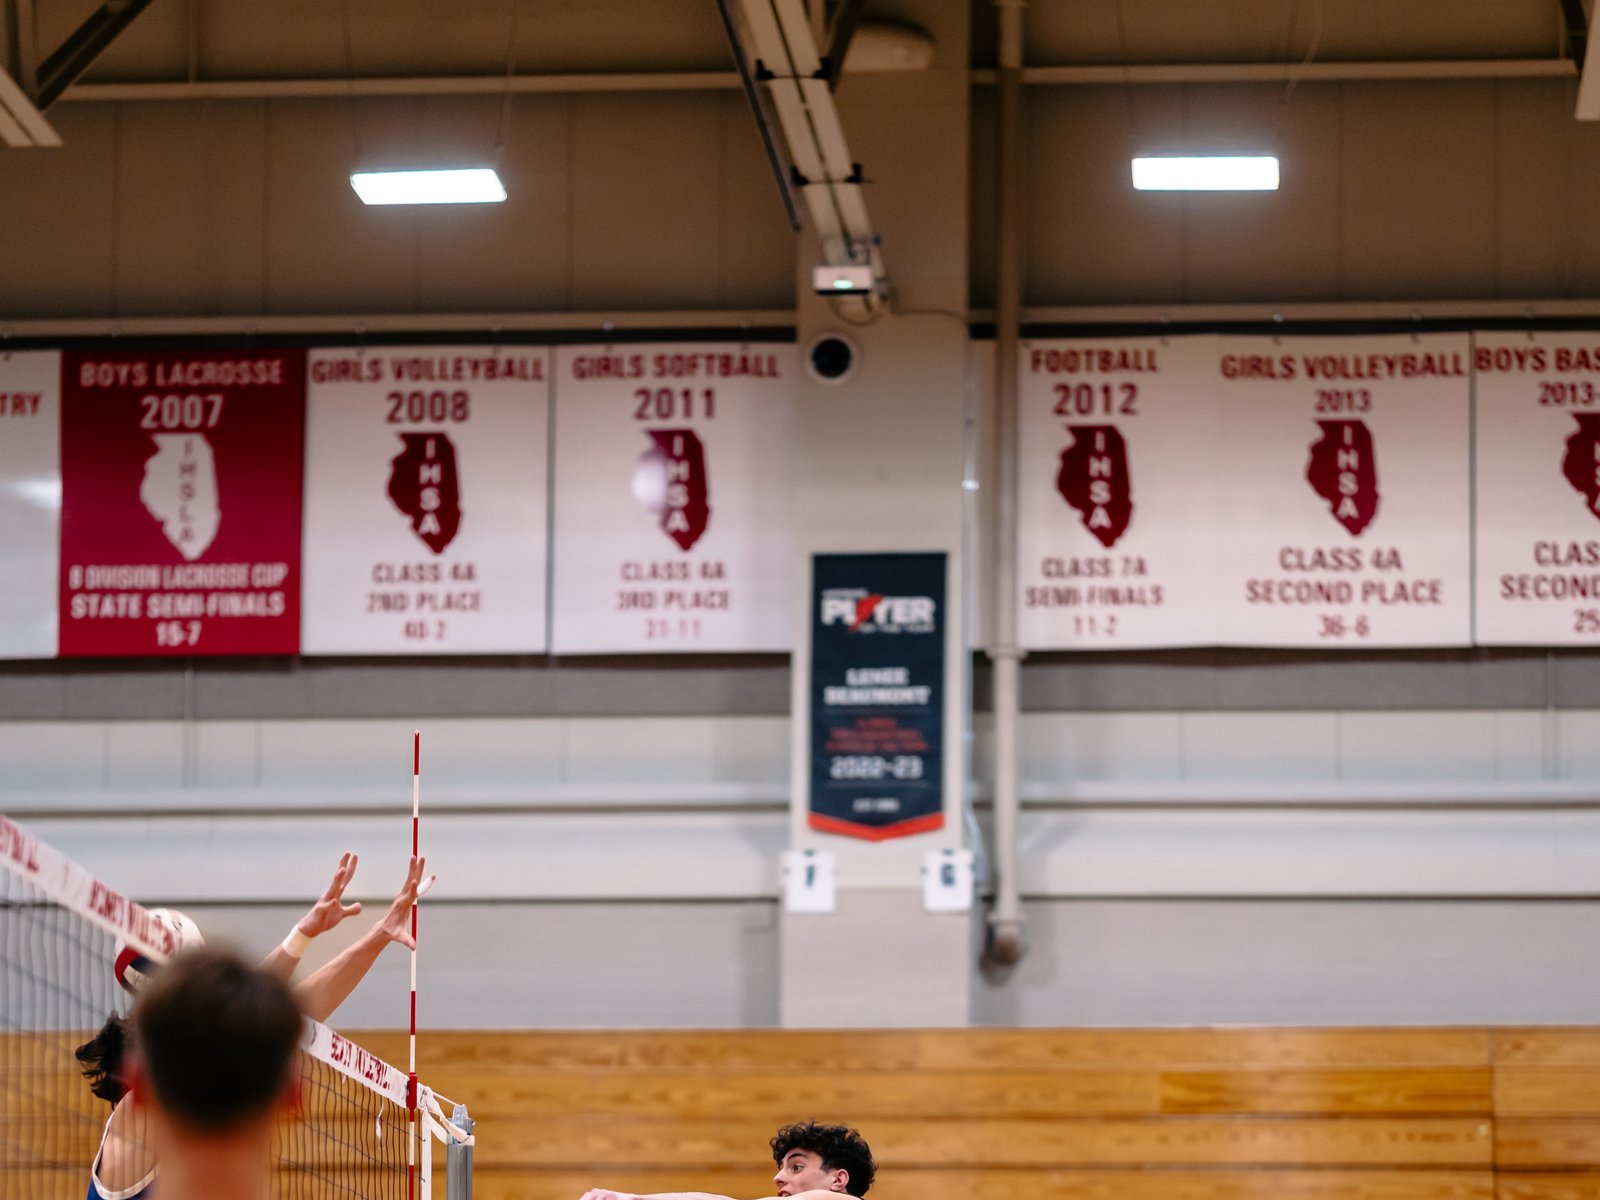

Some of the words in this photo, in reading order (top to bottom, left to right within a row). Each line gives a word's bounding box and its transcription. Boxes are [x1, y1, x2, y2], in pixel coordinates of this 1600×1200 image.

[311, 357, 384, 384] GIRLS
[390, 356, 544, 382] VOLLEYBALL
[572, 353, 645, 380] GIRLS
[652, 352, 781, 379] SOFTBALL
[1030, 348, 1158, 374] FOOTBALL
[1220, 354, 1296, 380] GIRLS
[1303, 352, 1464, 379] VOLLEYBALL
[1474, 346, 1546, 373] BOYS
[80, 361, 149, 388] BOYS
[155, 359, 285, 387] LACROSSE
[140, 394, 225, 429] 2007
[385, 390, 470, 424] 2008
[633, 387, 717, 421] 2011
[1053, 383, 1139, 416] 2012
[1313, 388, 1372, 414] 2013
[1088, 430, 1112, 529] IHSA
[1337, 424, 1360, 520] IHSA
[418, 437, 442, 536] IHSA
[371, 562, 442, 584] CLASS
[620, 560, 690, 582] CLASS
[1041, 556, 1113, 578] CLASS
[1279, 547, 1363, 572] CLASS
[416, 589, 482, 612] PLACE
[663, 588, 730, 610] PLACE
[1246, 578, 1354, 605] SECOND
[1360, 578, 1443, 604] PLACE
[71, 592, 143, 619] STATE
